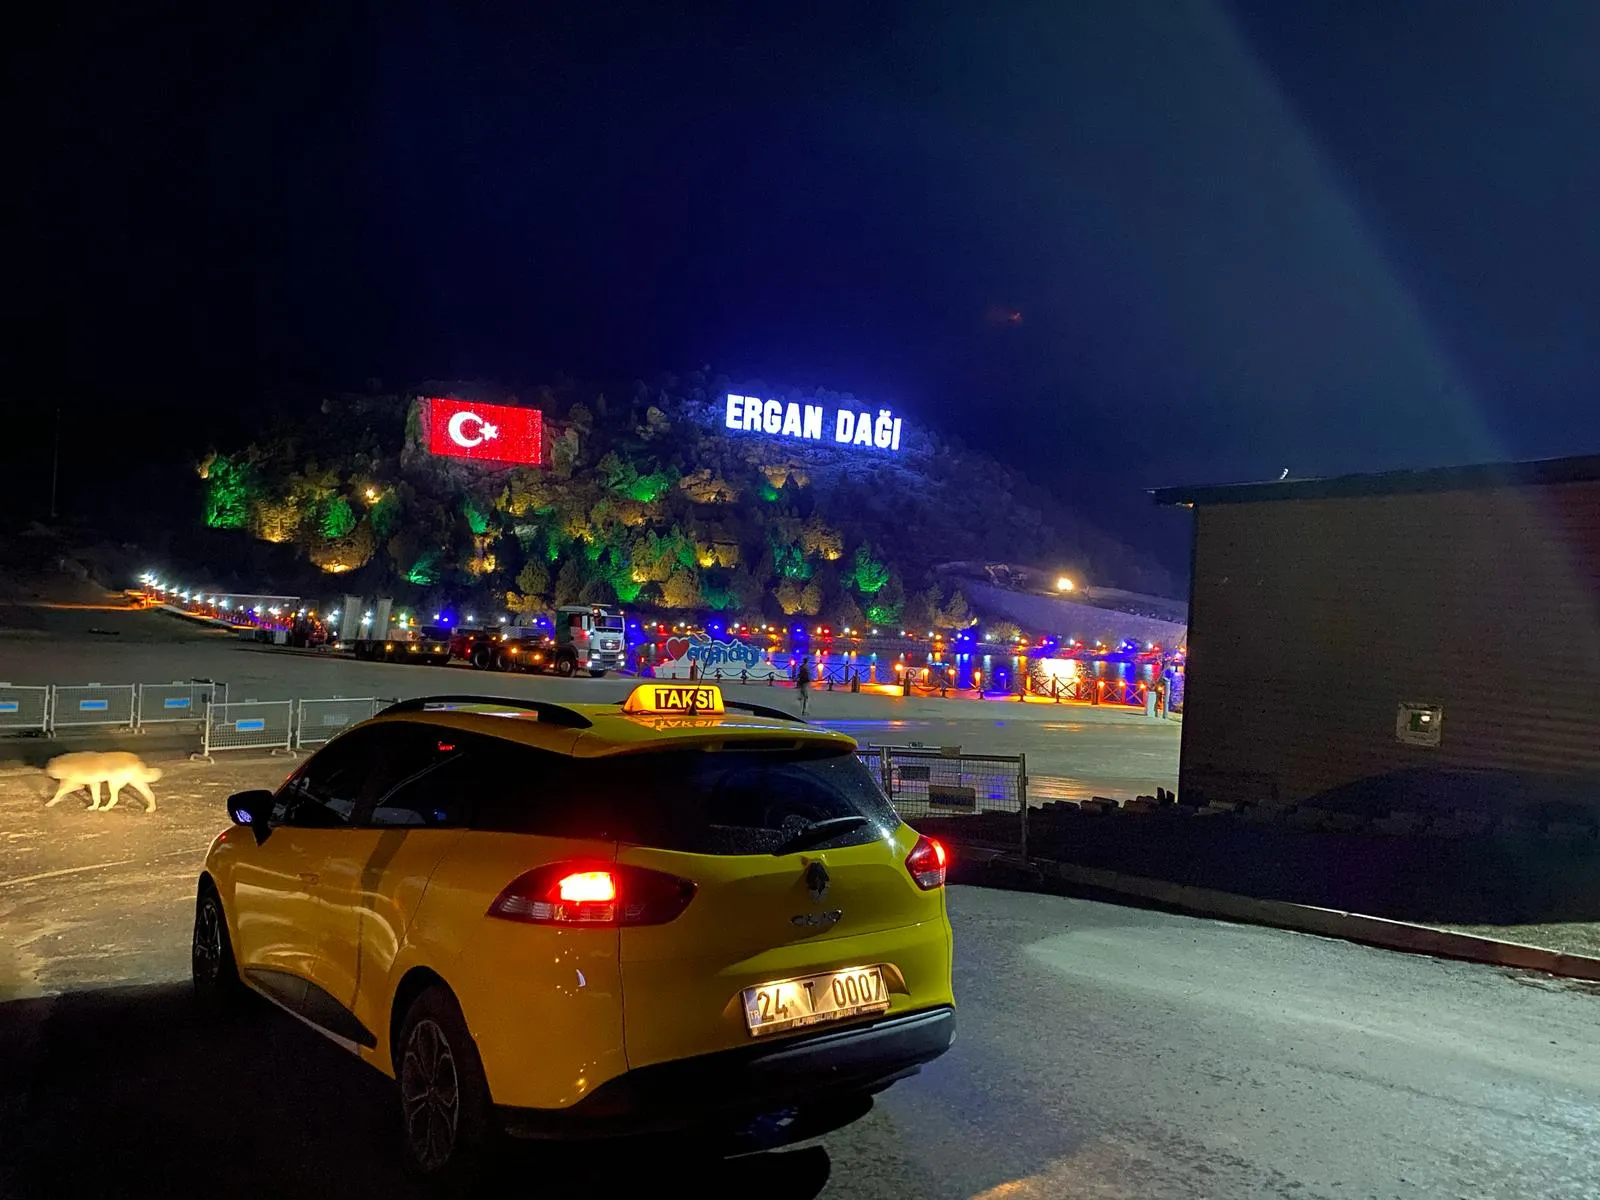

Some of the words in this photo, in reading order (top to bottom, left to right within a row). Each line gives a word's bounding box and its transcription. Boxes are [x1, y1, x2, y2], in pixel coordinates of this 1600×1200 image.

[726, 394, 823, 439] ERGAN
[836, 409, 901, 450] DAĞI
[749, 1010, 761, 1020] TR
[757, 989, 788, 1021] 24
[803, 982, 815, 1012] T
[832, 971, 880, 1008] 0007
